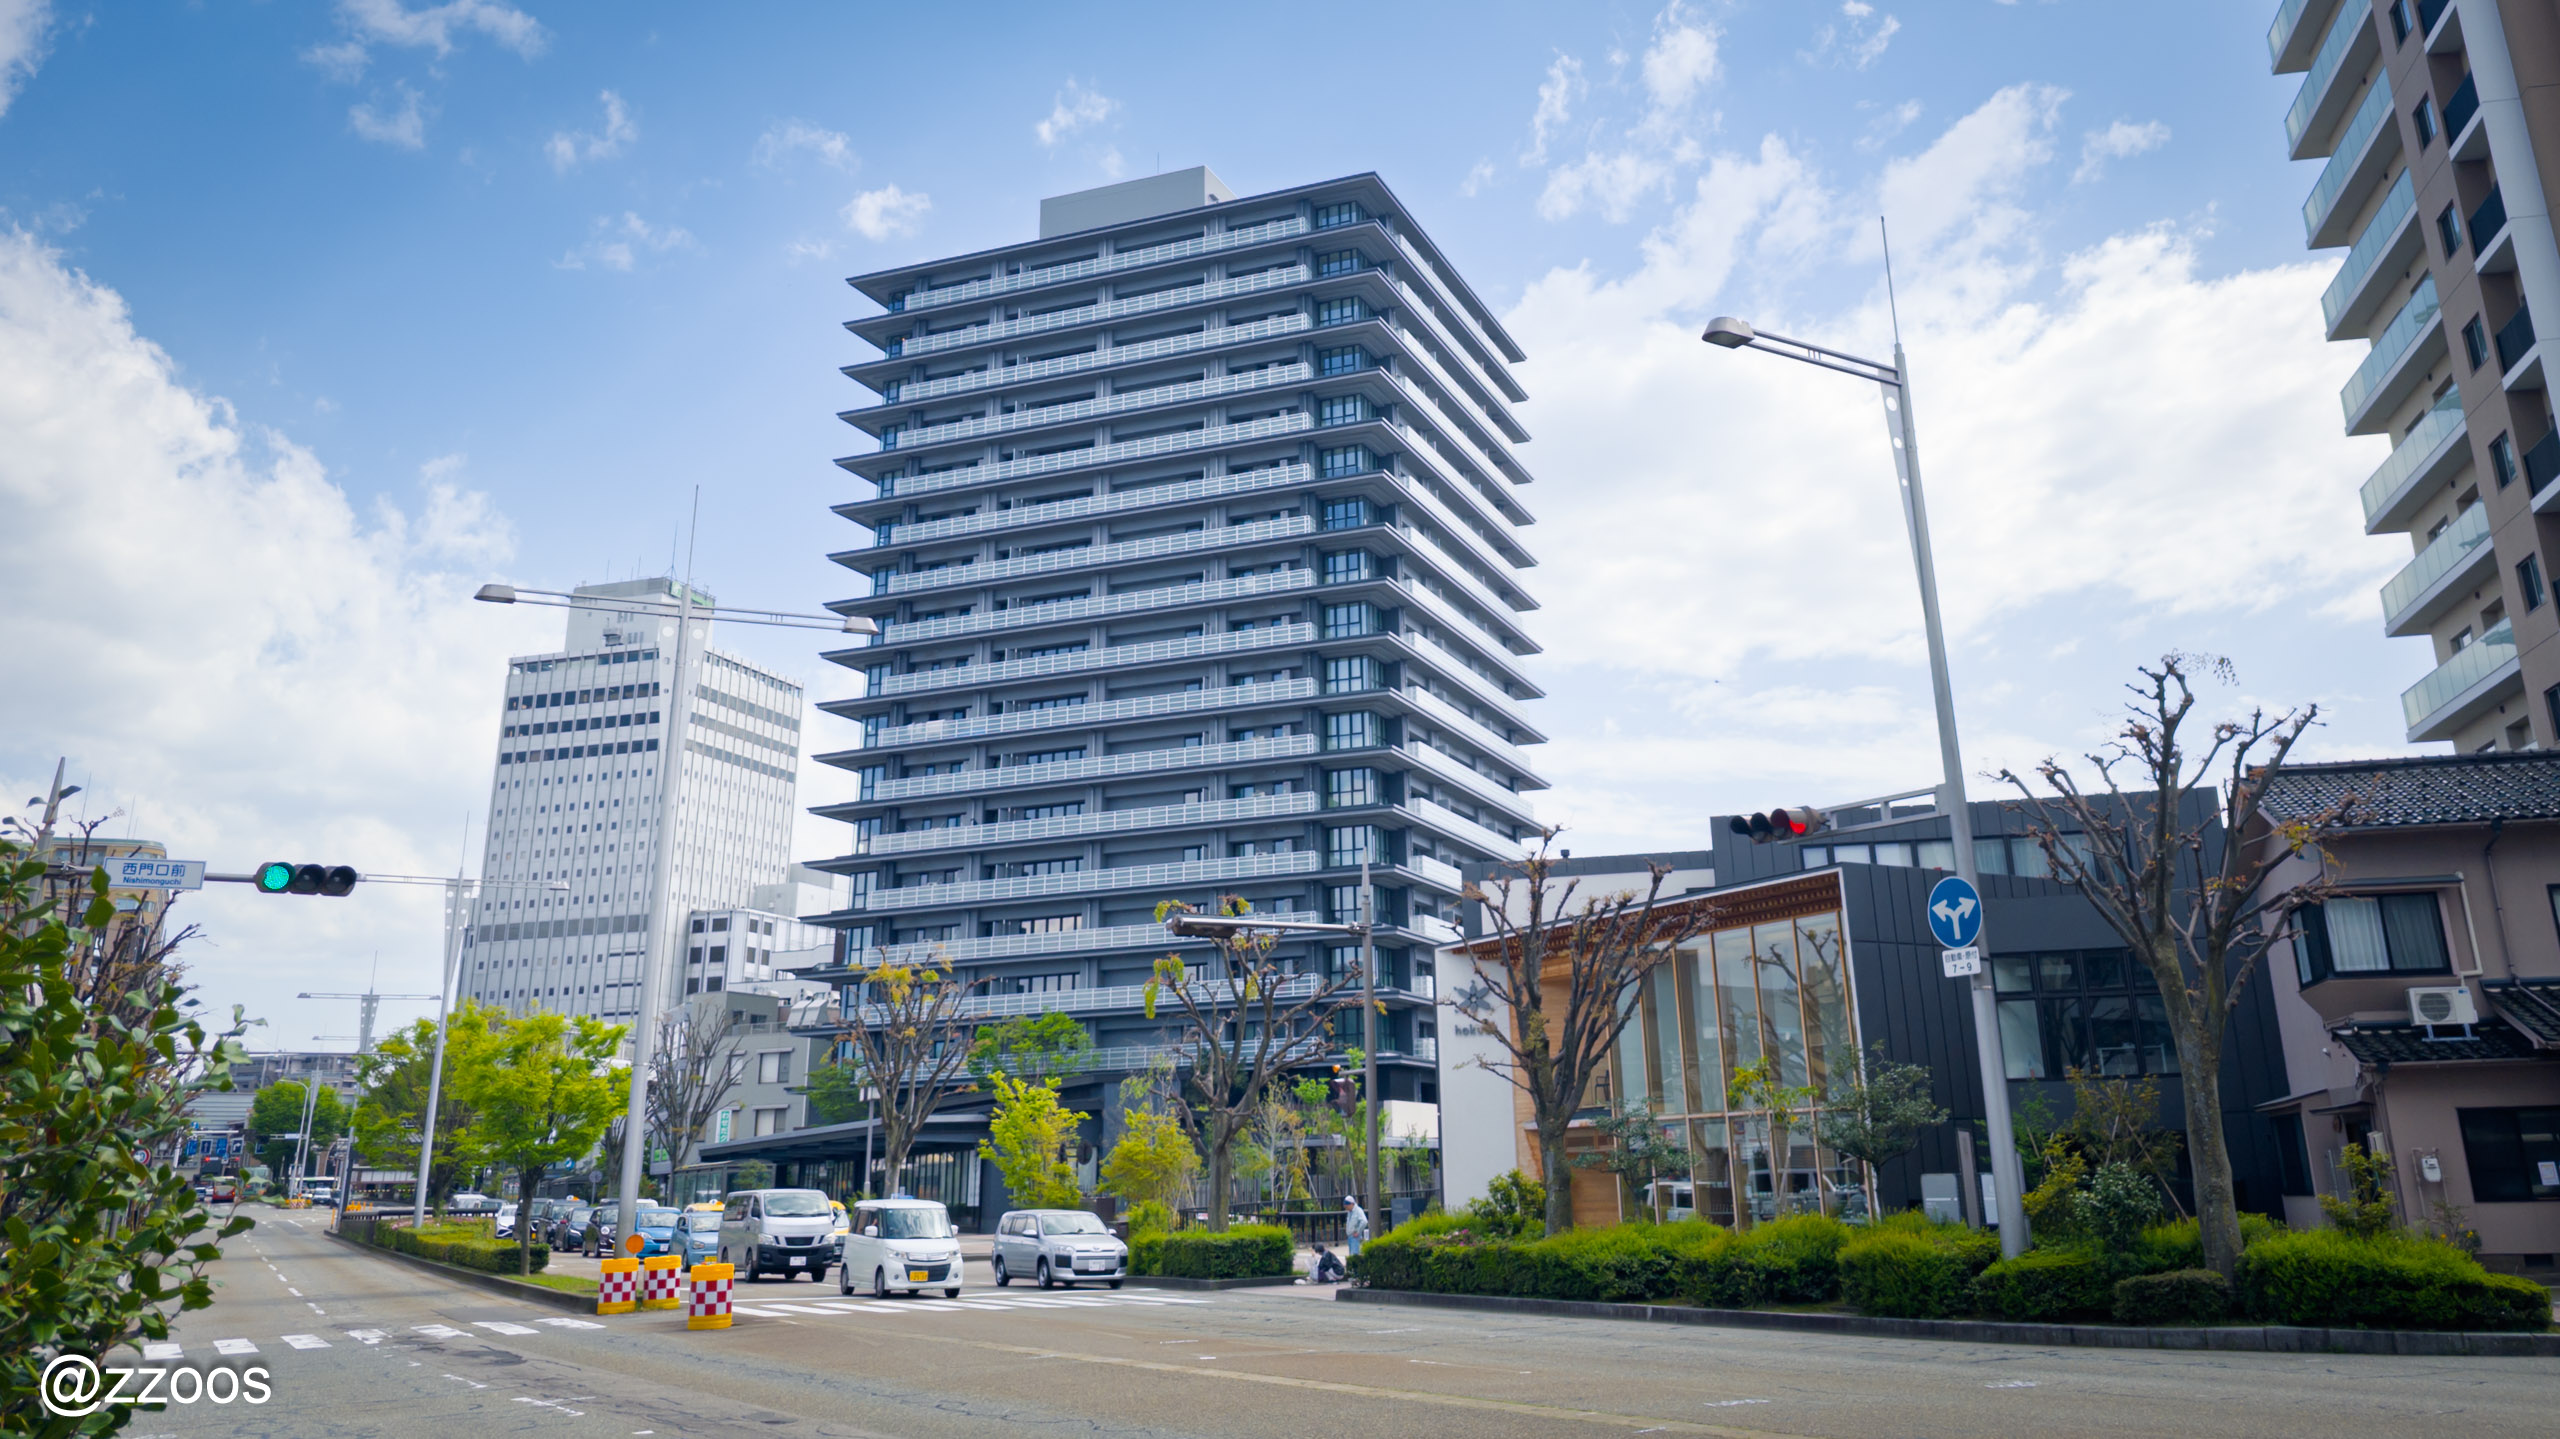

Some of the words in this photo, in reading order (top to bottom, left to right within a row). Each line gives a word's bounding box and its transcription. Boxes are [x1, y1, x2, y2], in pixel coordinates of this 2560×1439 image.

[122, 862, 186, 877] 西門口前
[122, 876, 182, 886] Nishimonguchi
